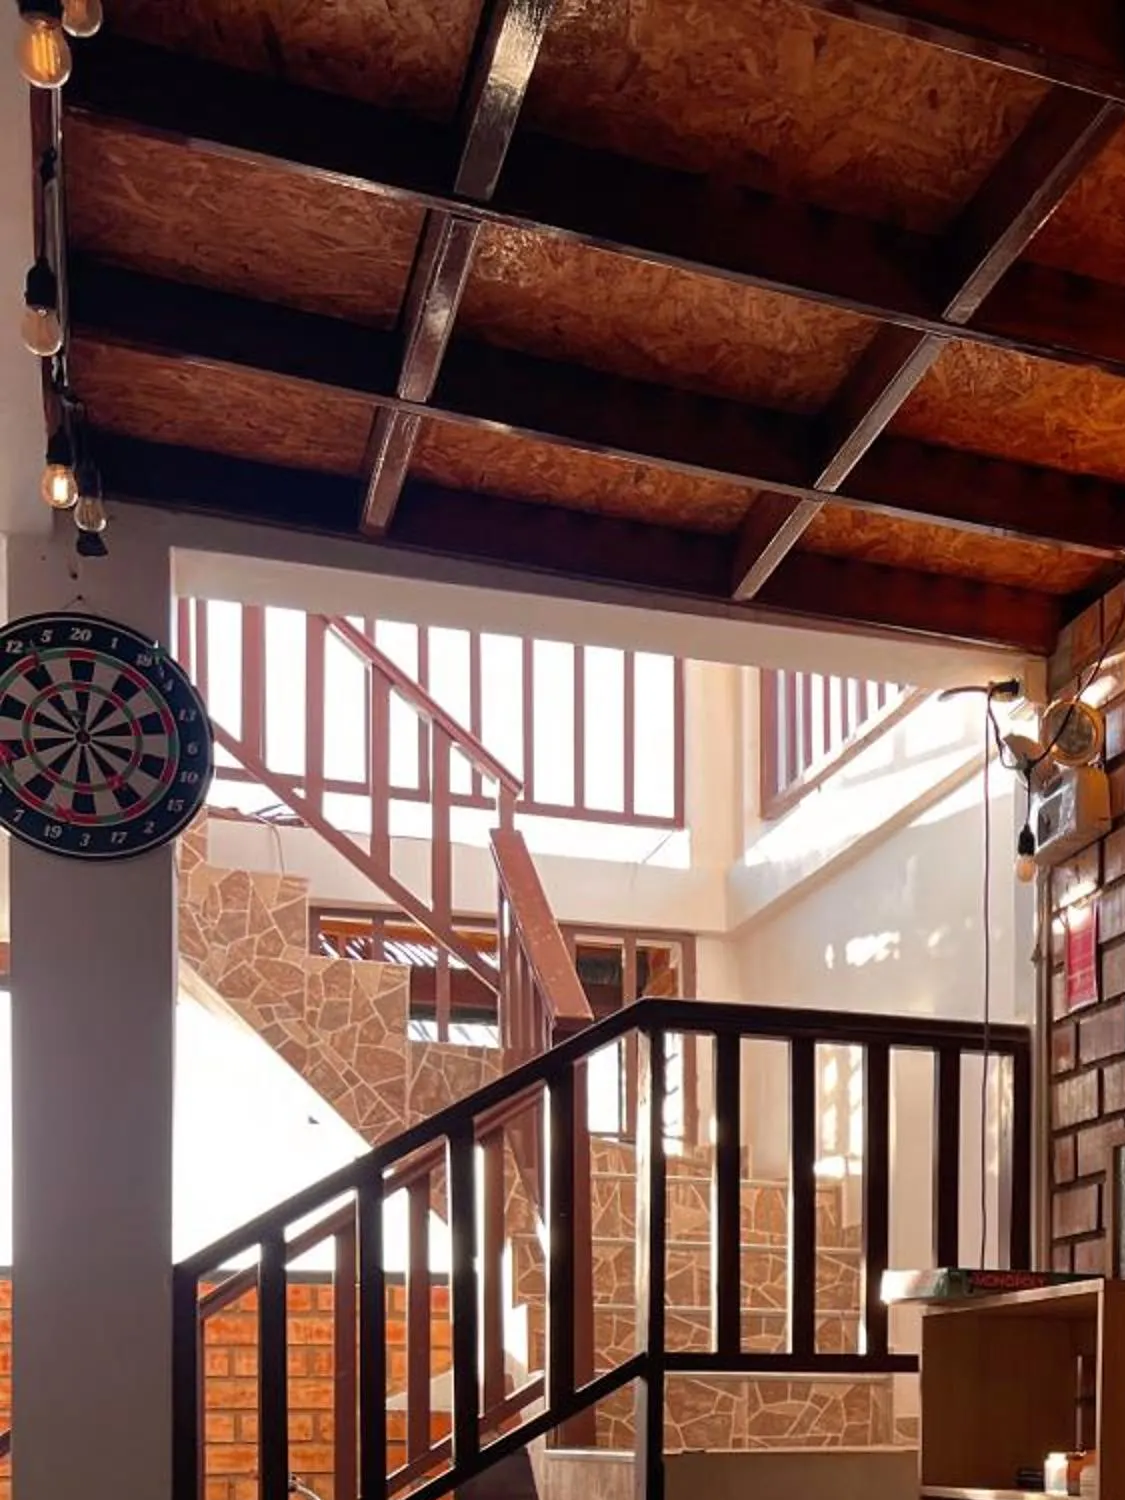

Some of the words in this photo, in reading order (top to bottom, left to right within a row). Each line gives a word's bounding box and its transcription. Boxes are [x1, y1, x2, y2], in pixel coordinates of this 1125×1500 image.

[41, 629, 53, 643] 5
[70, 627, 92, 641] 20
[5, 641, 23, 653] 12
[111, 637, 118, 649] 1
[187, 742, 198, 755] 6
[180, 771, 198, 783] 10
[166, 799, 184, 812] 15
[12, 809, 25, 823] 7
[44, 825, 63, 839] 19
[110, 831, 128, 844] 17
[79, 833, 91, 847] 3
[973, 1273, 1045, 1288] MONOPOLY
